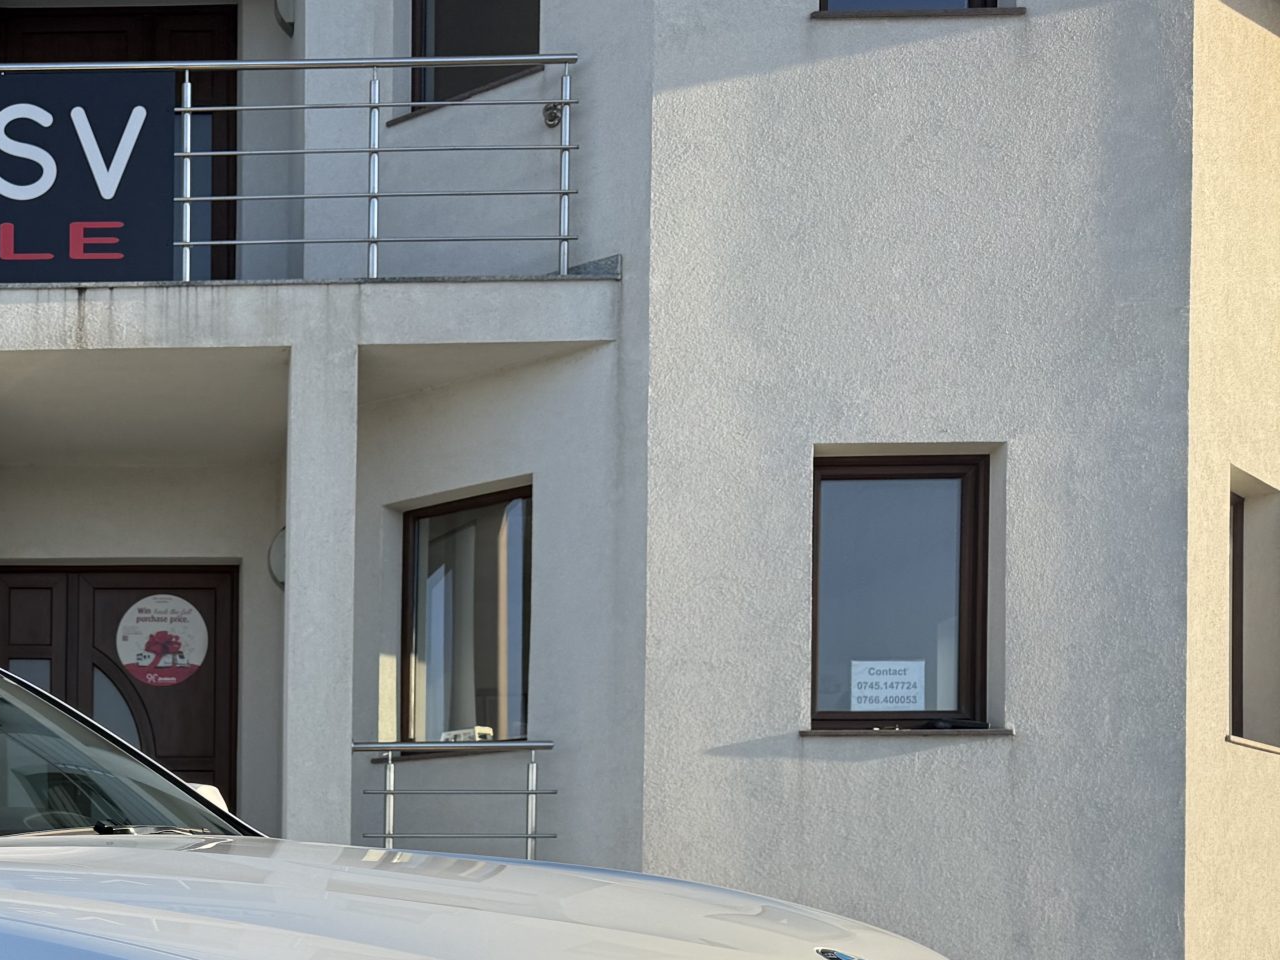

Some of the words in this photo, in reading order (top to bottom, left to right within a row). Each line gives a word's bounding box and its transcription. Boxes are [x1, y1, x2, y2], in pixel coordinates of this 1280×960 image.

[137, 607, 152, 615] Win
[136, 614, 169, 624] purchase
[867, 667, 908, 676] Contact
[856, 681, 918, 690] 0745.147724
[856, 695, 918, 705] 0766.400053
